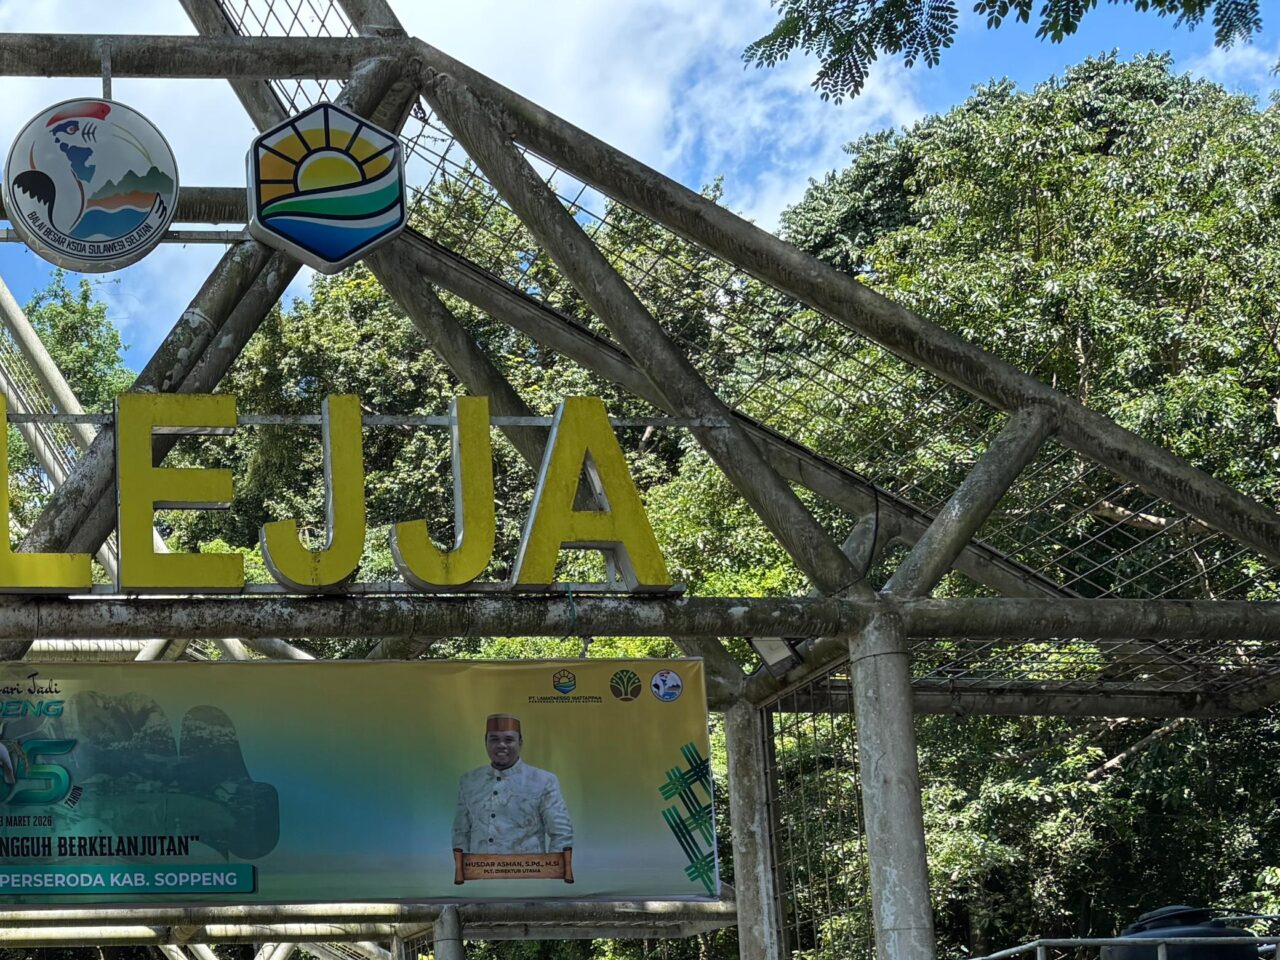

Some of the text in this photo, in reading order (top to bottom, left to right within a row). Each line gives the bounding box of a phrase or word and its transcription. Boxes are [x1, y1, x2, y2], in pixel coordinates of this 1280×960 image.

[27, 211, 44, 232] BALAI
[42, 227, 67, 247] BESAR
[88, 240, 126, 254] SULAWESI
[124, 222, 154, 247] SELATAN
[26, 672, 61, 695] Jadi
[5, 816, 31, 827] MARET
[57, 834, 201, 857] BERKELANJUTAN"
[110, 872, 150, 887] KAB.
[154, 872, 238, 887] SOPPENG
